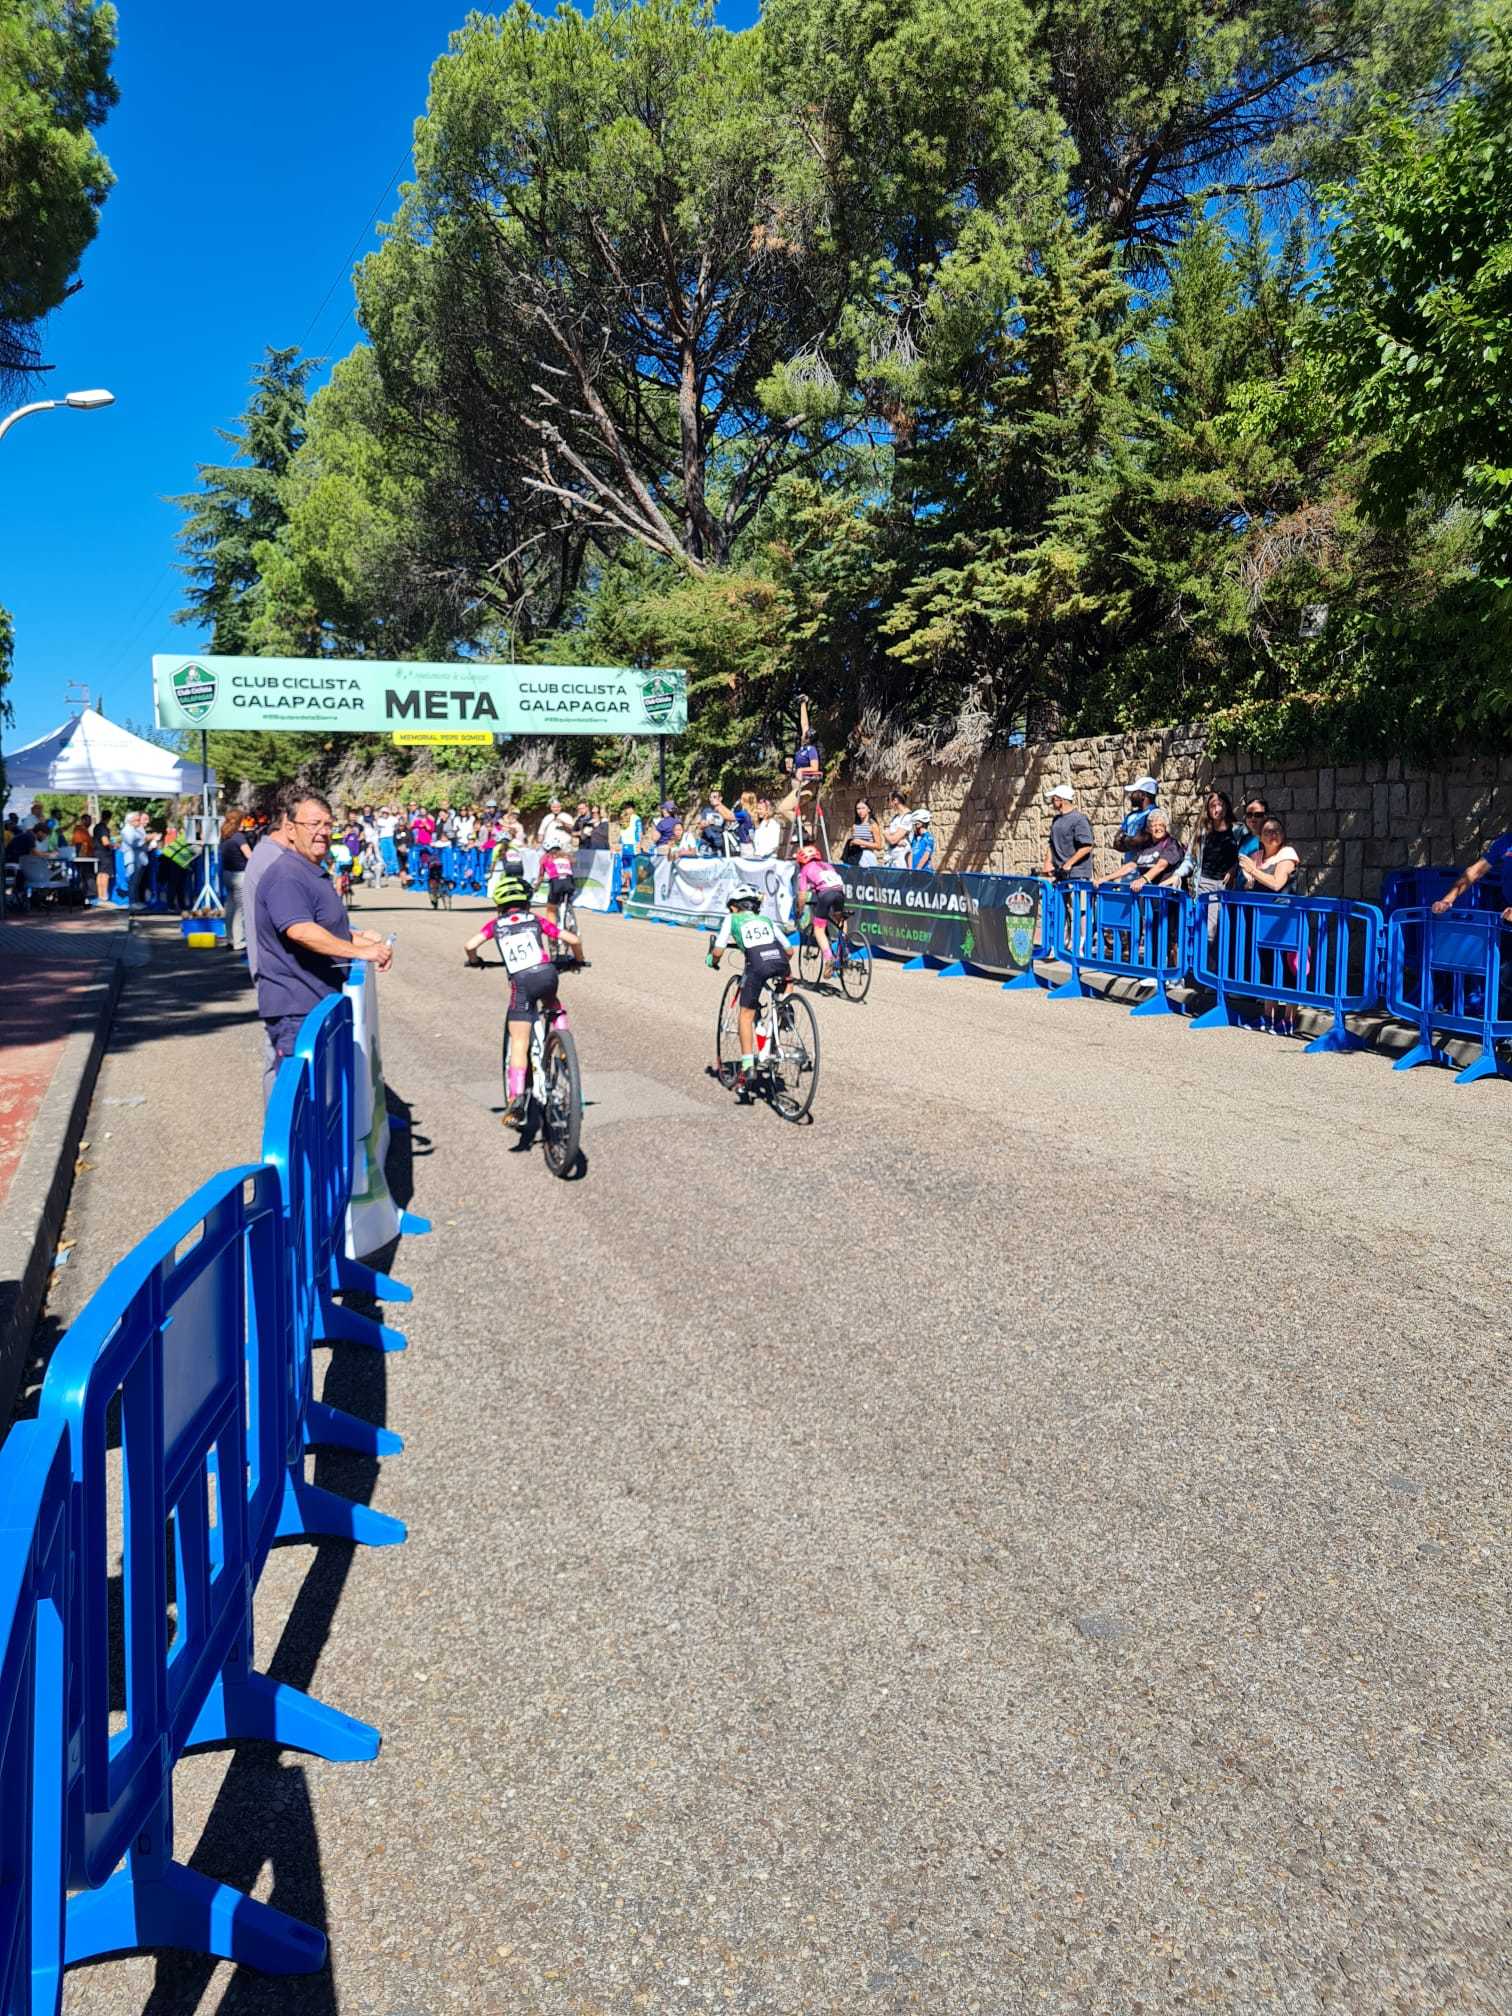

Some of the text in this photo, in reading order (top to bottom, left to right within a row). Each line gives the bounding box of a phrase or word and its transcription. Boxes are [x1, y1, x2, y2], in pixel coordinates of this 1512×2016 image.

[232, 676, 361, 690] CLUB CICLISTA
[519, 683, 628, 696] CLUB CICLISTA
[232, 695, 365, 710] GALAPAGAR
[385, 689, 499, 720] META
[519, 700, 631, 713] GALAPAGAR
[856, 886, 902, 906] CICLISTA
[745, 926, 770, 941] 454
[508, 940, 534, 962] 451
